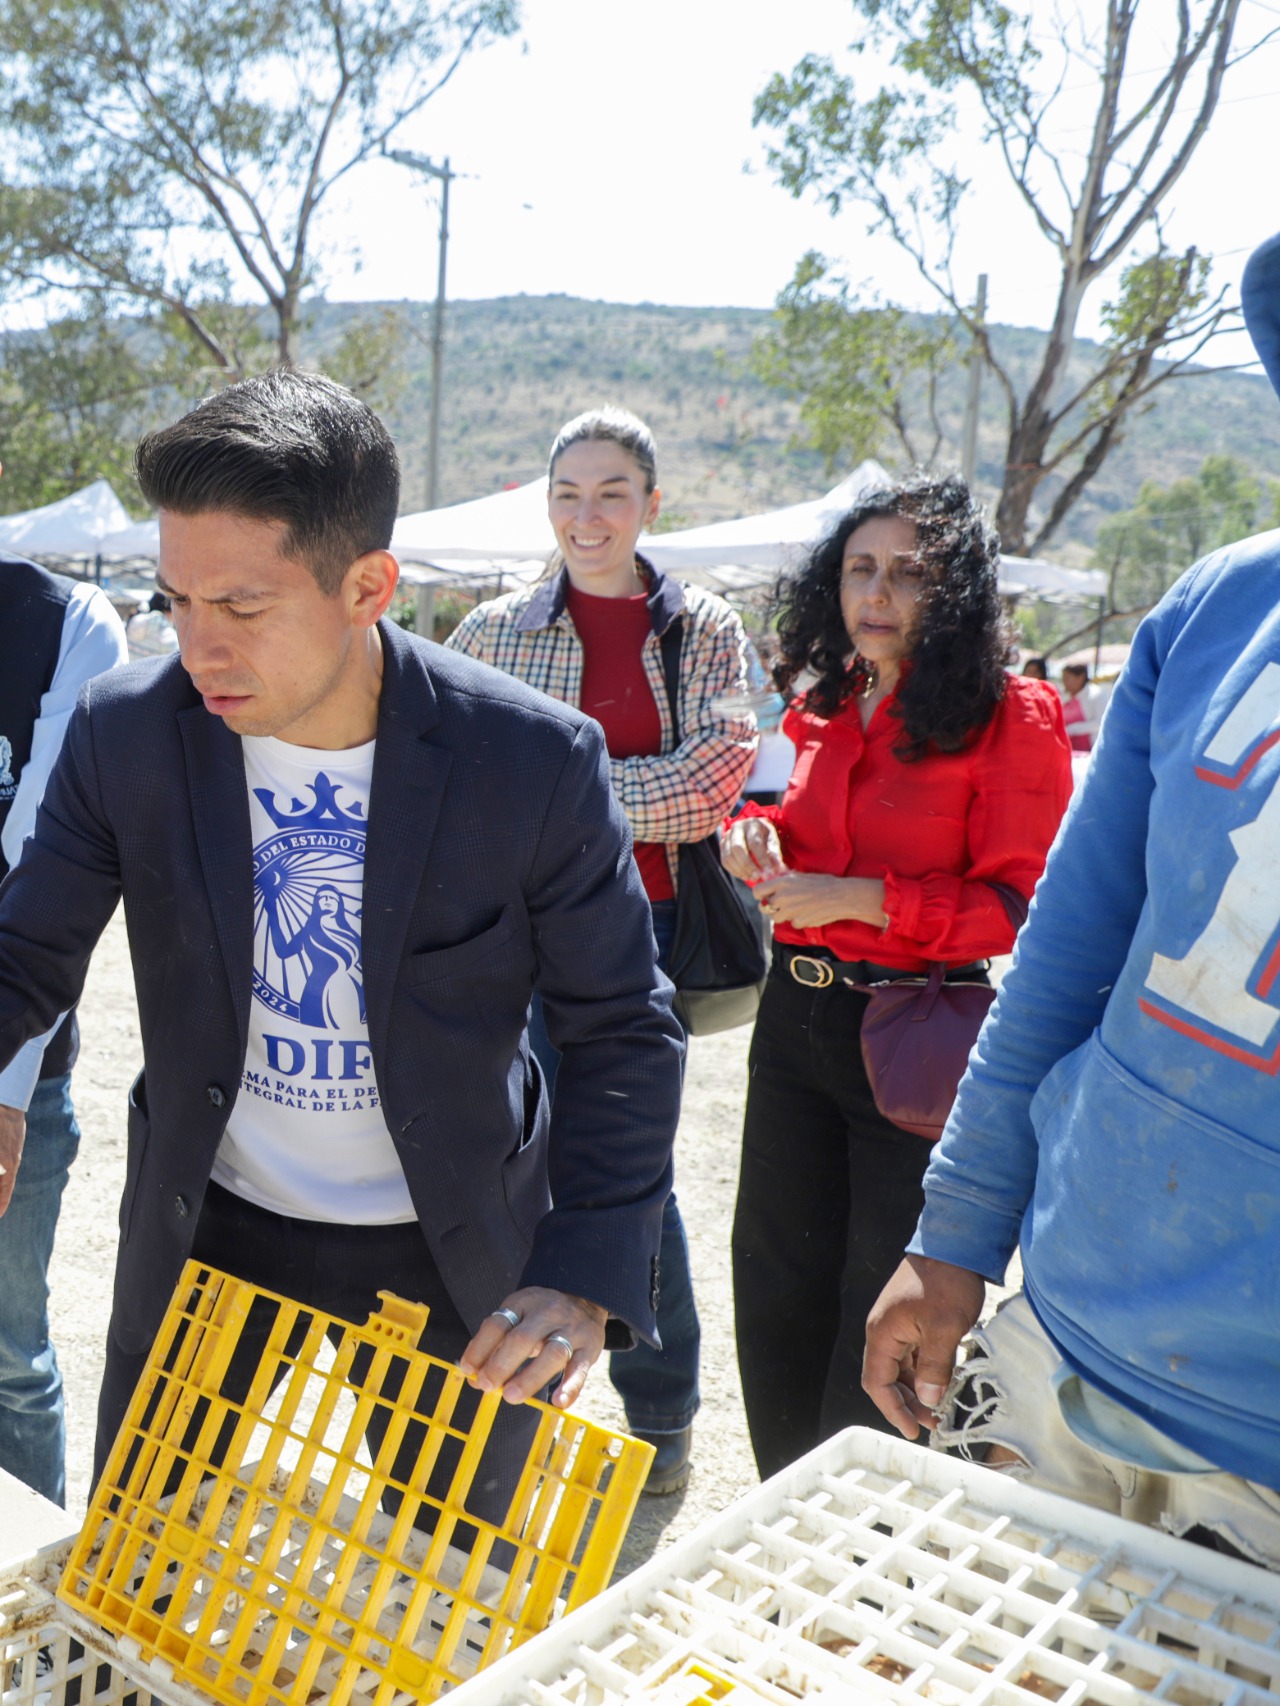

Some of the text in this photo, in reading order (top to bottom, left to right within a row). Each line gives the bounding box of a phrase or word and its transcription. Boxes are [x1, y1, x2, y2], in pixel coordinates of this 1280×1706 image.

[260, 841, 289, 863] DEL
[290, 834, 351, 848] ESTADO
[252, 981, 288, 1012] 2024
[262, 1033, 371, 1081] DIF
[242, 1070, 270, 1088] MA
[276, 1080, 320, 1099] PARA
[326, 1088, 347, 1099] EL
[312, 1101, 335, 1112] DE
[341, 1100, 363, 1111] LA
